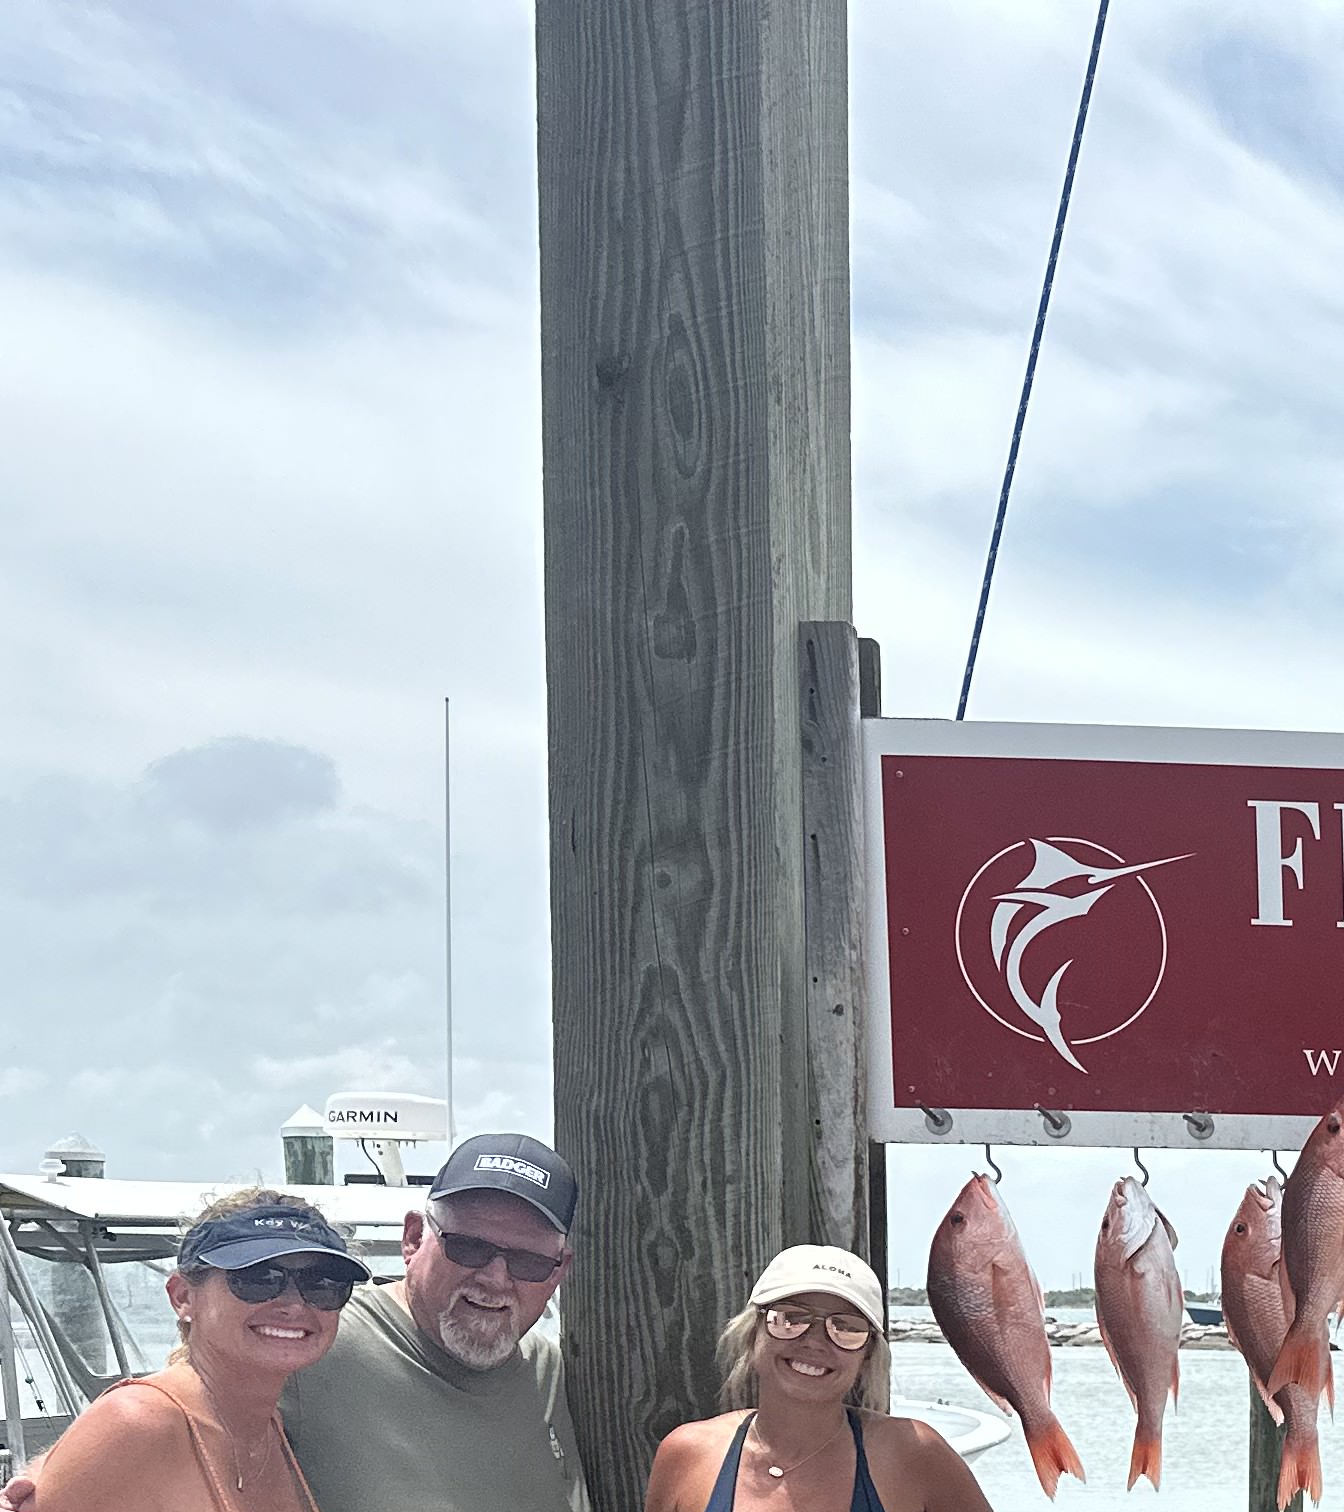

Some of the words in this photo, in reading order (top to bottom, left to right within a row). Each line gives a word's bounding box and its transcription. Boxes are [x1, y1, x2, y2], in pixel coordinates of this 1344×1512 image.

[328, 1110, 398, 1122] GARMIN
[479, 1157, 545, 1184] BADGER
[812, 1264, 852, 1279] ALOHA
